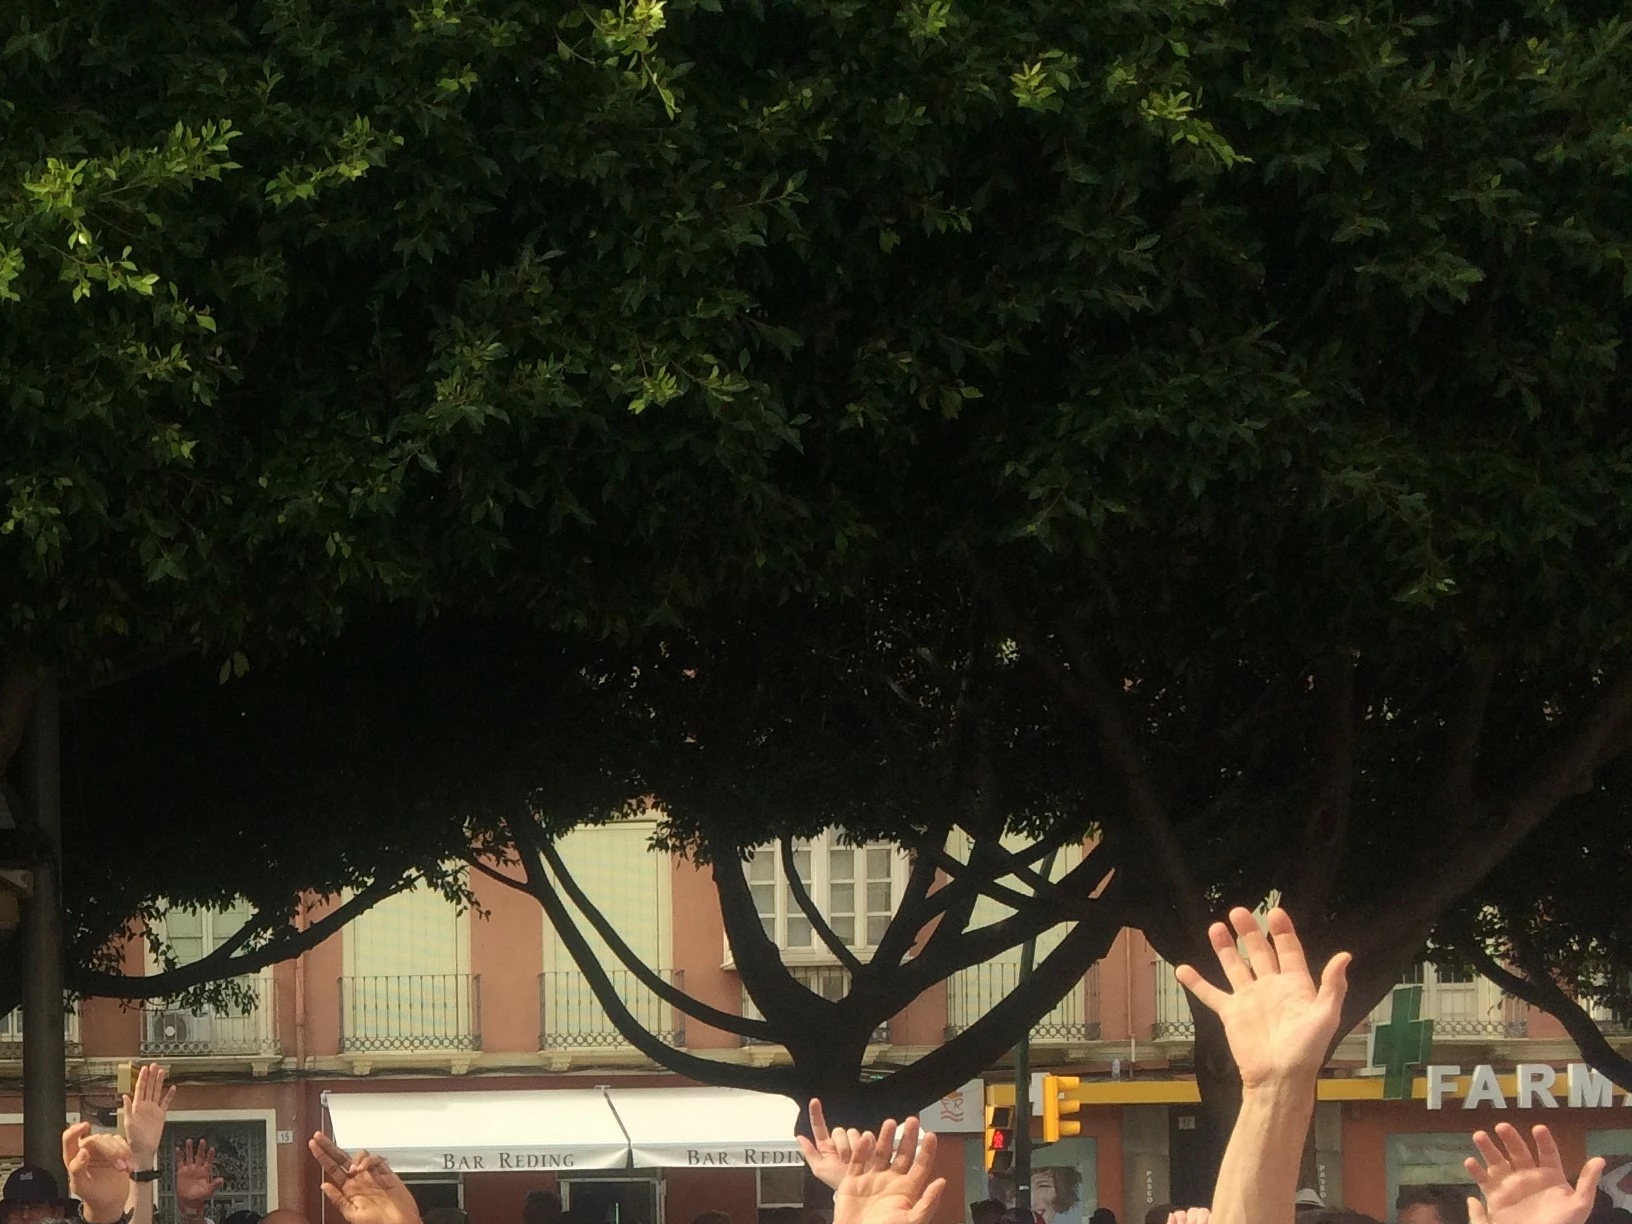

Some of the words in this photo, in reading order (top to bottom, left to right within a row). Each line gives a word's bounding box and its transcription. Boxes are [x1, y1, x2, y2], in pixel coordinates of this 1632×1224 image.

[1426, 1063, 1632, 1111] FARM
[280, 1133, 290, 1142] 15
[744, 1149, 806, 1165] REDIN
[1146, 1170, 1154, 1204] PASEO
